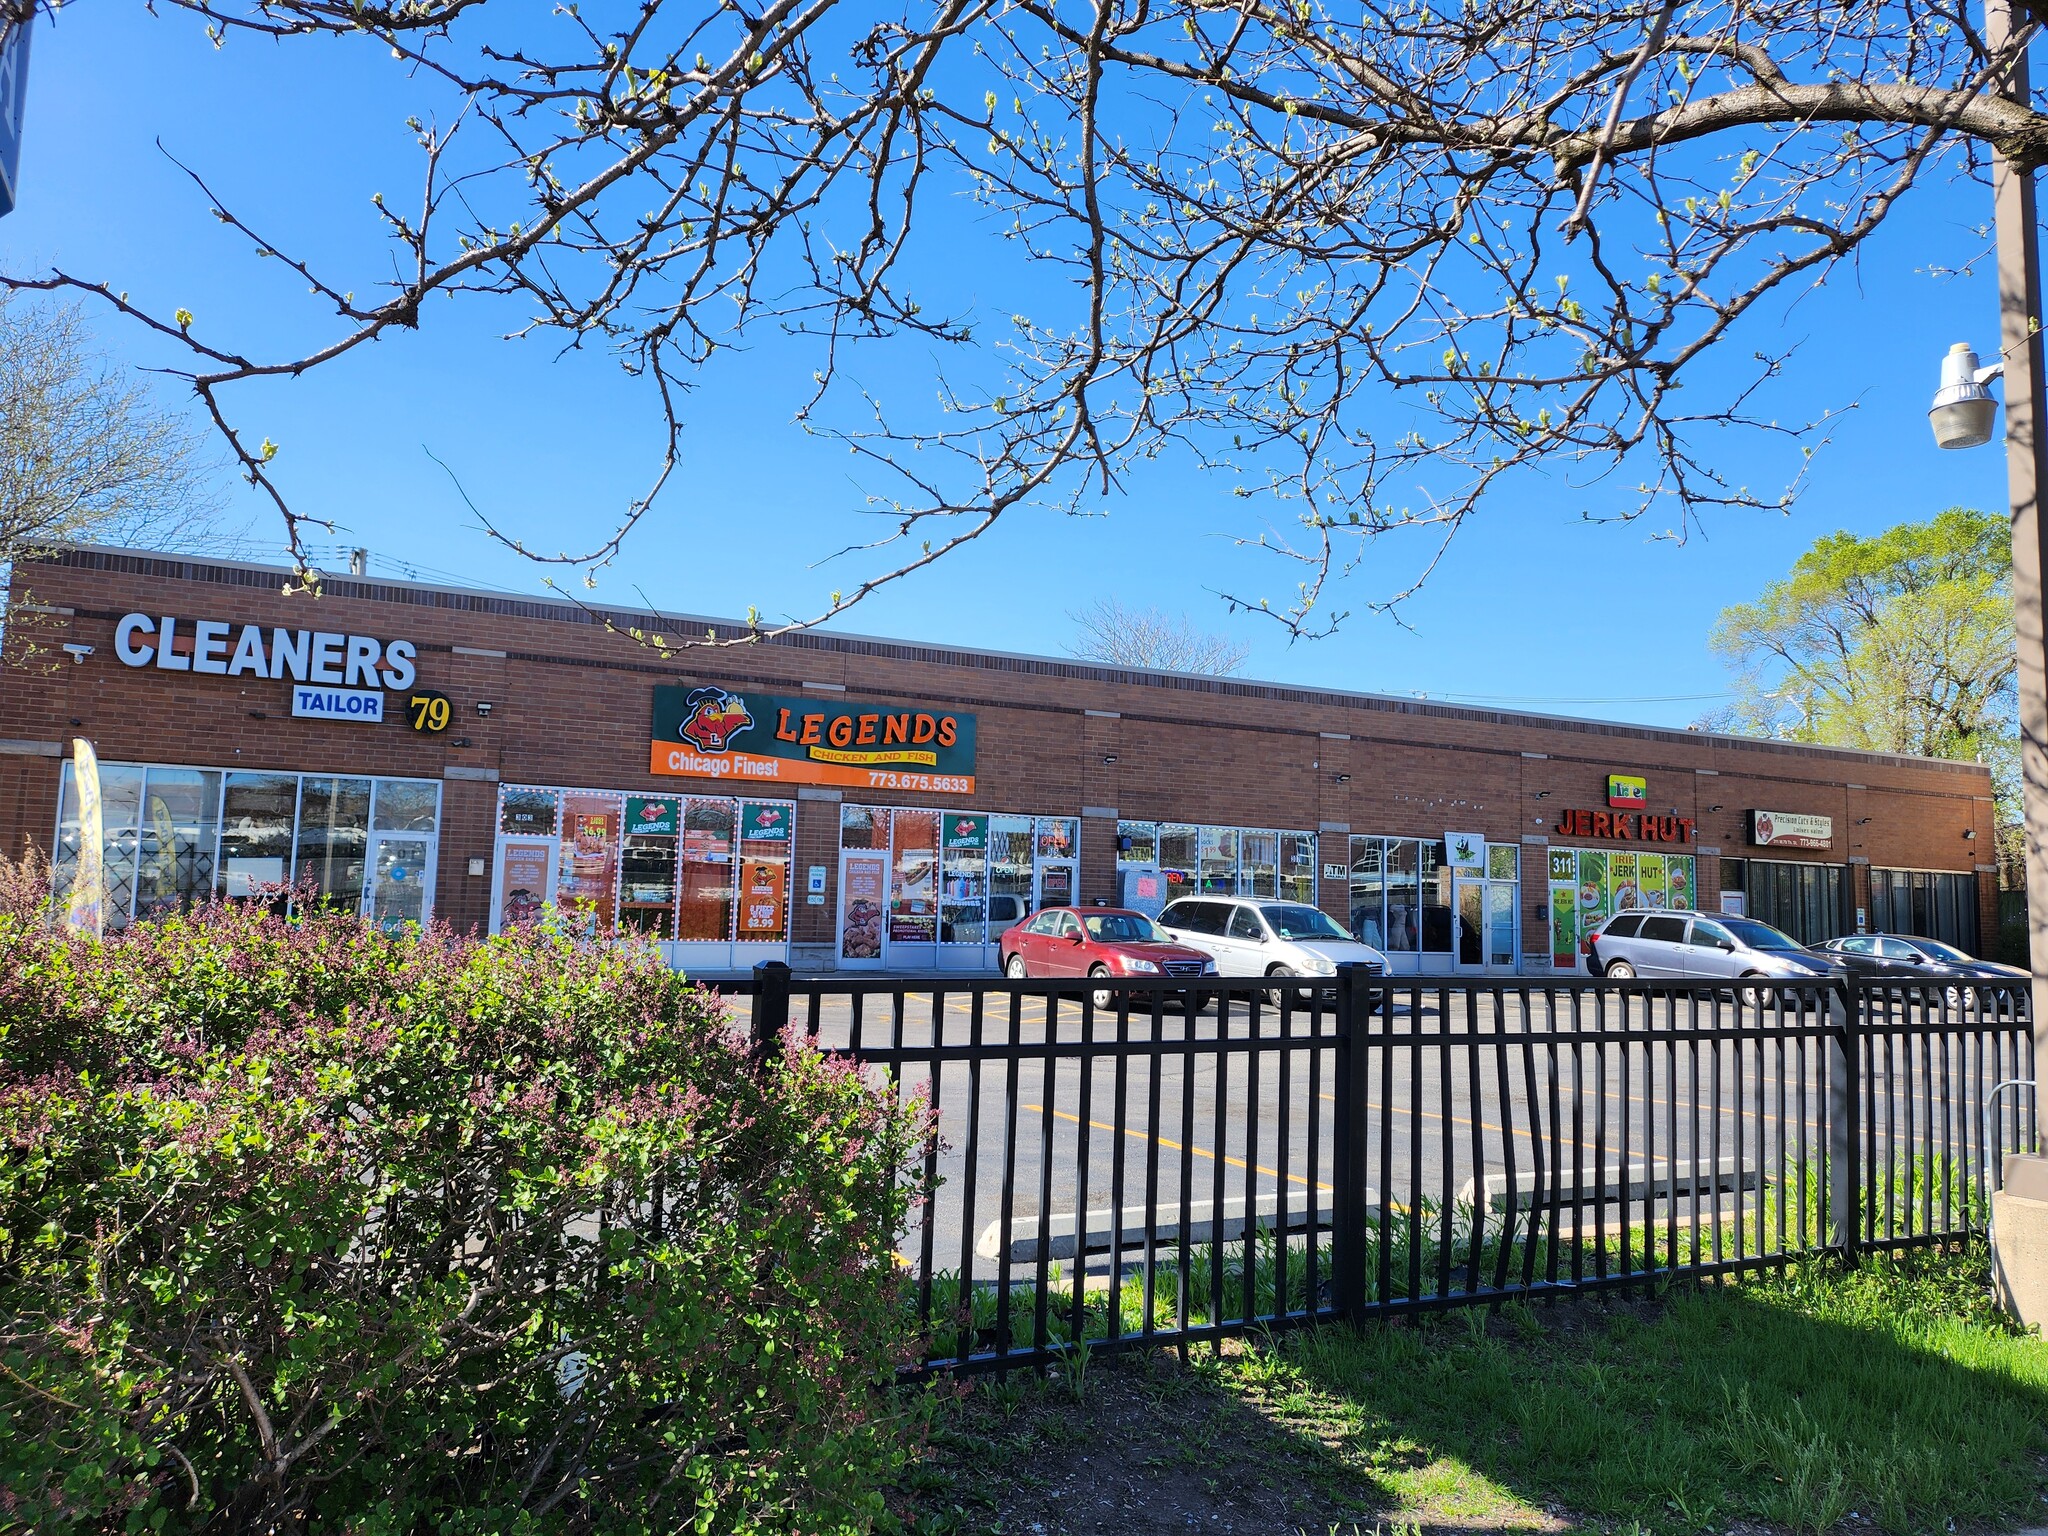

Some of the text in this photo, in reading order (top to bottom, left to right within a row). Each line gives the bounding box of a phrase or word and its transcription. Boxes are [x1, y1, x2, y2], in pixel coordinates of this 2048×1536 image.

[115, 612, 417, 691] CLEANERS
[298, 692, 378, 716] TAILOR
[410, 696, 451, 731] 79
[776, 707, 958, 747] LEGENDS
[813, 749, 934, 763] CHICKEN AND FISH
[668, 751, 779, 777] Chicago Finest
[869, 771, 968, 792] 773.675.5633
[1613, 782, 1643, 799] Irie
[632, 821, 671, 830] LEGENDS
[1557, 809, 1695, 843] JERK HUT
[1774, 814, 1797, 824] Precision
[1814, 818, 1830, 829] Styles
[583, 825, 607, 837] $6.99
[749, 827, 784, 836] LEGENDS
[948, 836, 979, 845] LEGENDS
[507, 849, 545, 858] LEGENDS
[1129, 847, 1150, 858] ATM
[1553, 857, 1571, 874] 311
[1615, 855, 1634, 864] IRIE
[849, 863, 880, 871] LEGENDS
[948, 868, 975, 878] LEGENDS
[995, 866, 1014, 874] OPEN
[1325, 865, 1346, 876] ATM
[1613, 865, 1658, 879] JERK HUT
[748, 917, 774, 929] $2.99
